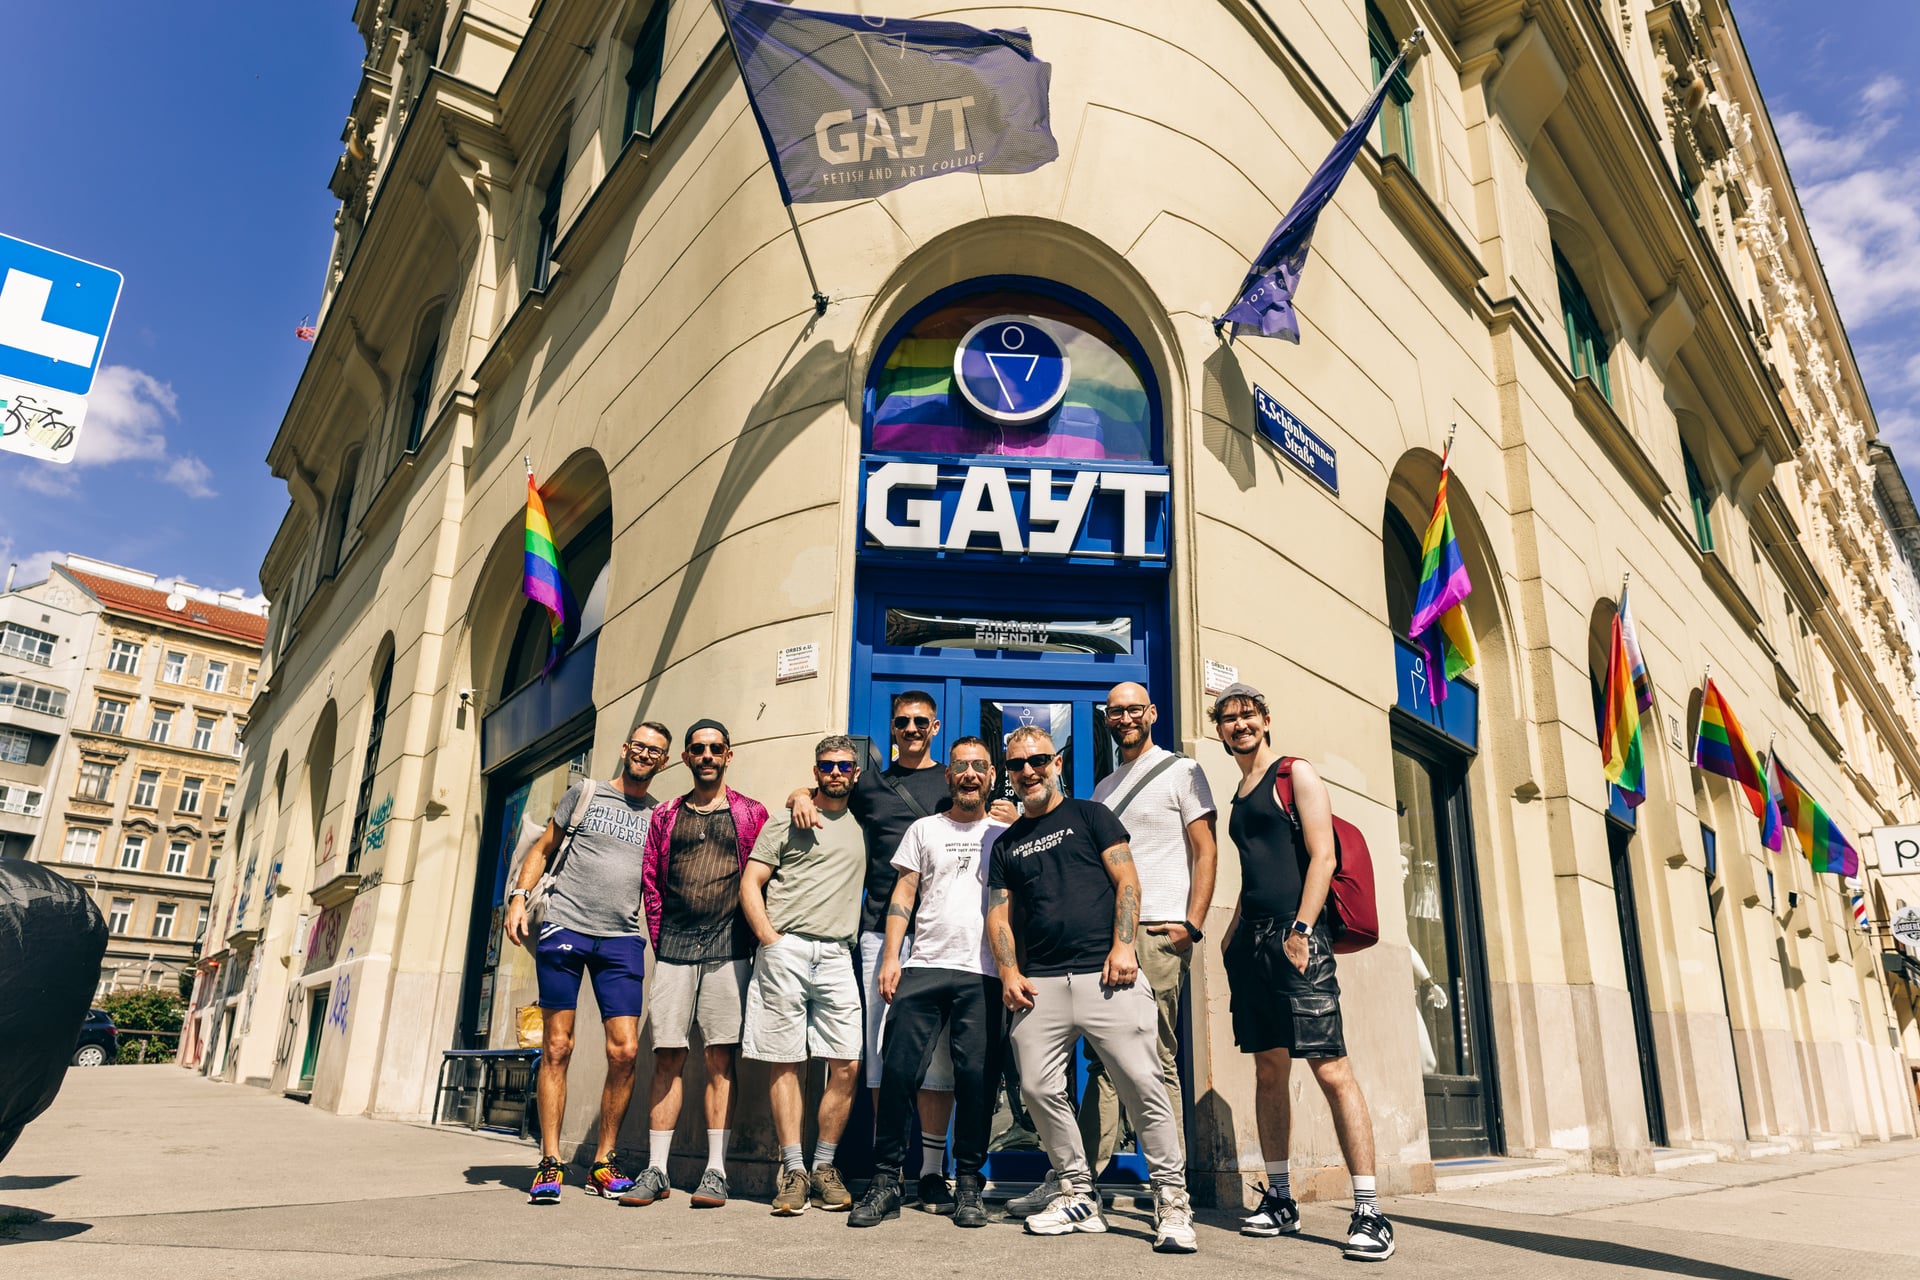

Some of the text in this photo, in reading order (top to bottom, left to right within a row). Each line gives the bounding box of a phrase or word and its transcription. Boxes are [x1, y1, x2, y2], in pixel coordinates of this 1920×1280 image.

[814, 96, 975, 165] GAYT
[823, 153, 984, 185] FETISH AND ART COLLIDE
[1269, 402, 1335, 468] Schönbrunner
[1284, 430, 1315, 468] Straße
[865, 463, 1170, 558] GAYT
[975, 620, 1048, 633] STRAIGHT
[975, 632, 1049, 646] FRIENDLY
[579, 817, 648, 849] UNIVERSI
[586, 804, 649, 834] COLUMB
[1012, 828, 1075, 857] HOW ABOUT A
[1022, 837, 1063, 857] BROJOB?
